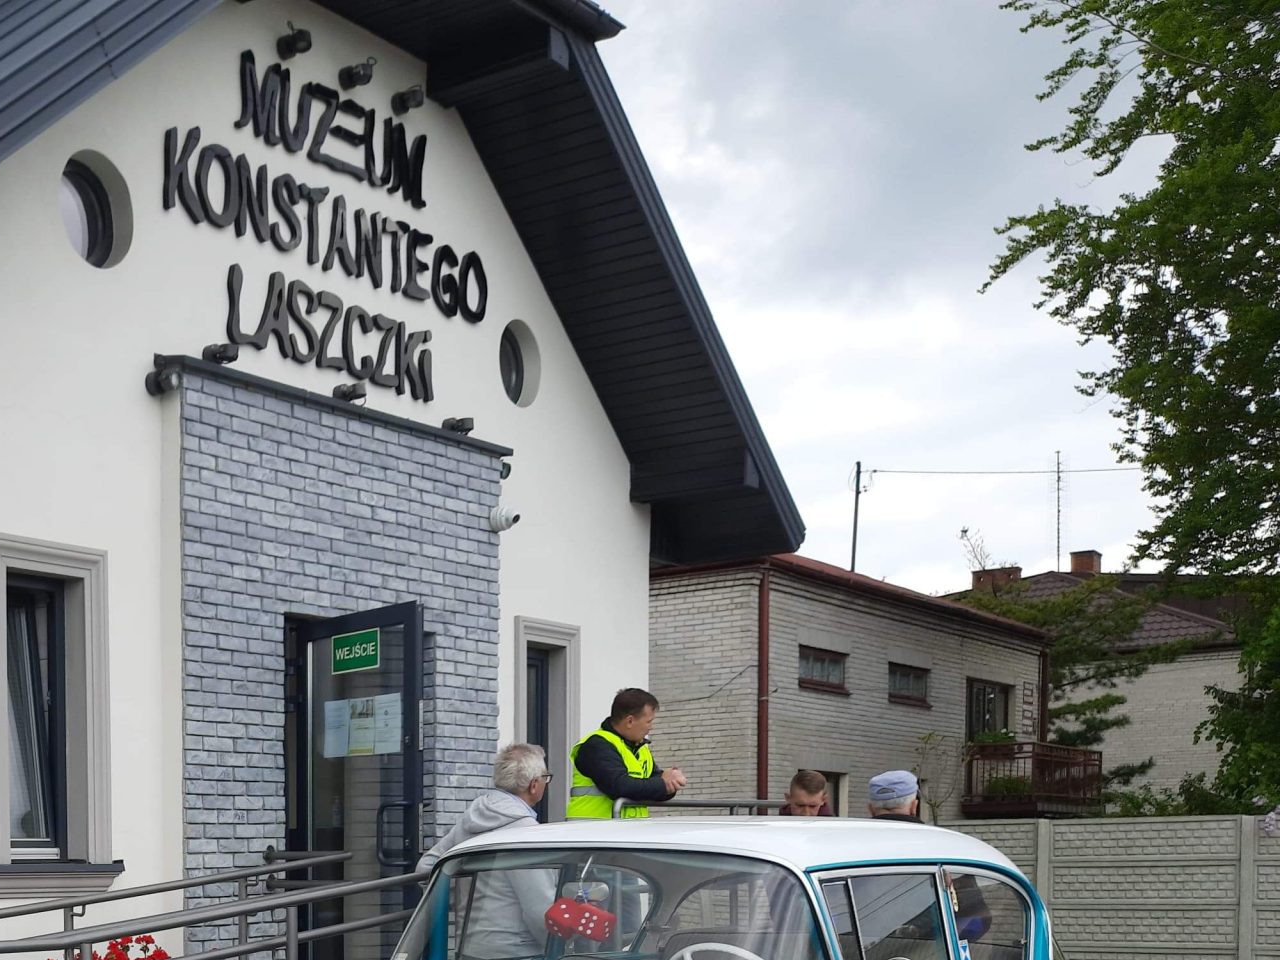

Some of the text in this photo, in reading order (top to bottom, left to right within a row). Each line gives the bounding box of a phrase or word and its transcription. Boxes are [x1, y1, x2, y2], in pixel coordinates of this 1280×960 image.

[234, 49, 427, 209] MUZEUM
[163, 126, 488, 324] KONSTANTEGO
[335, 641, 376, 660] WEJŚCIE
